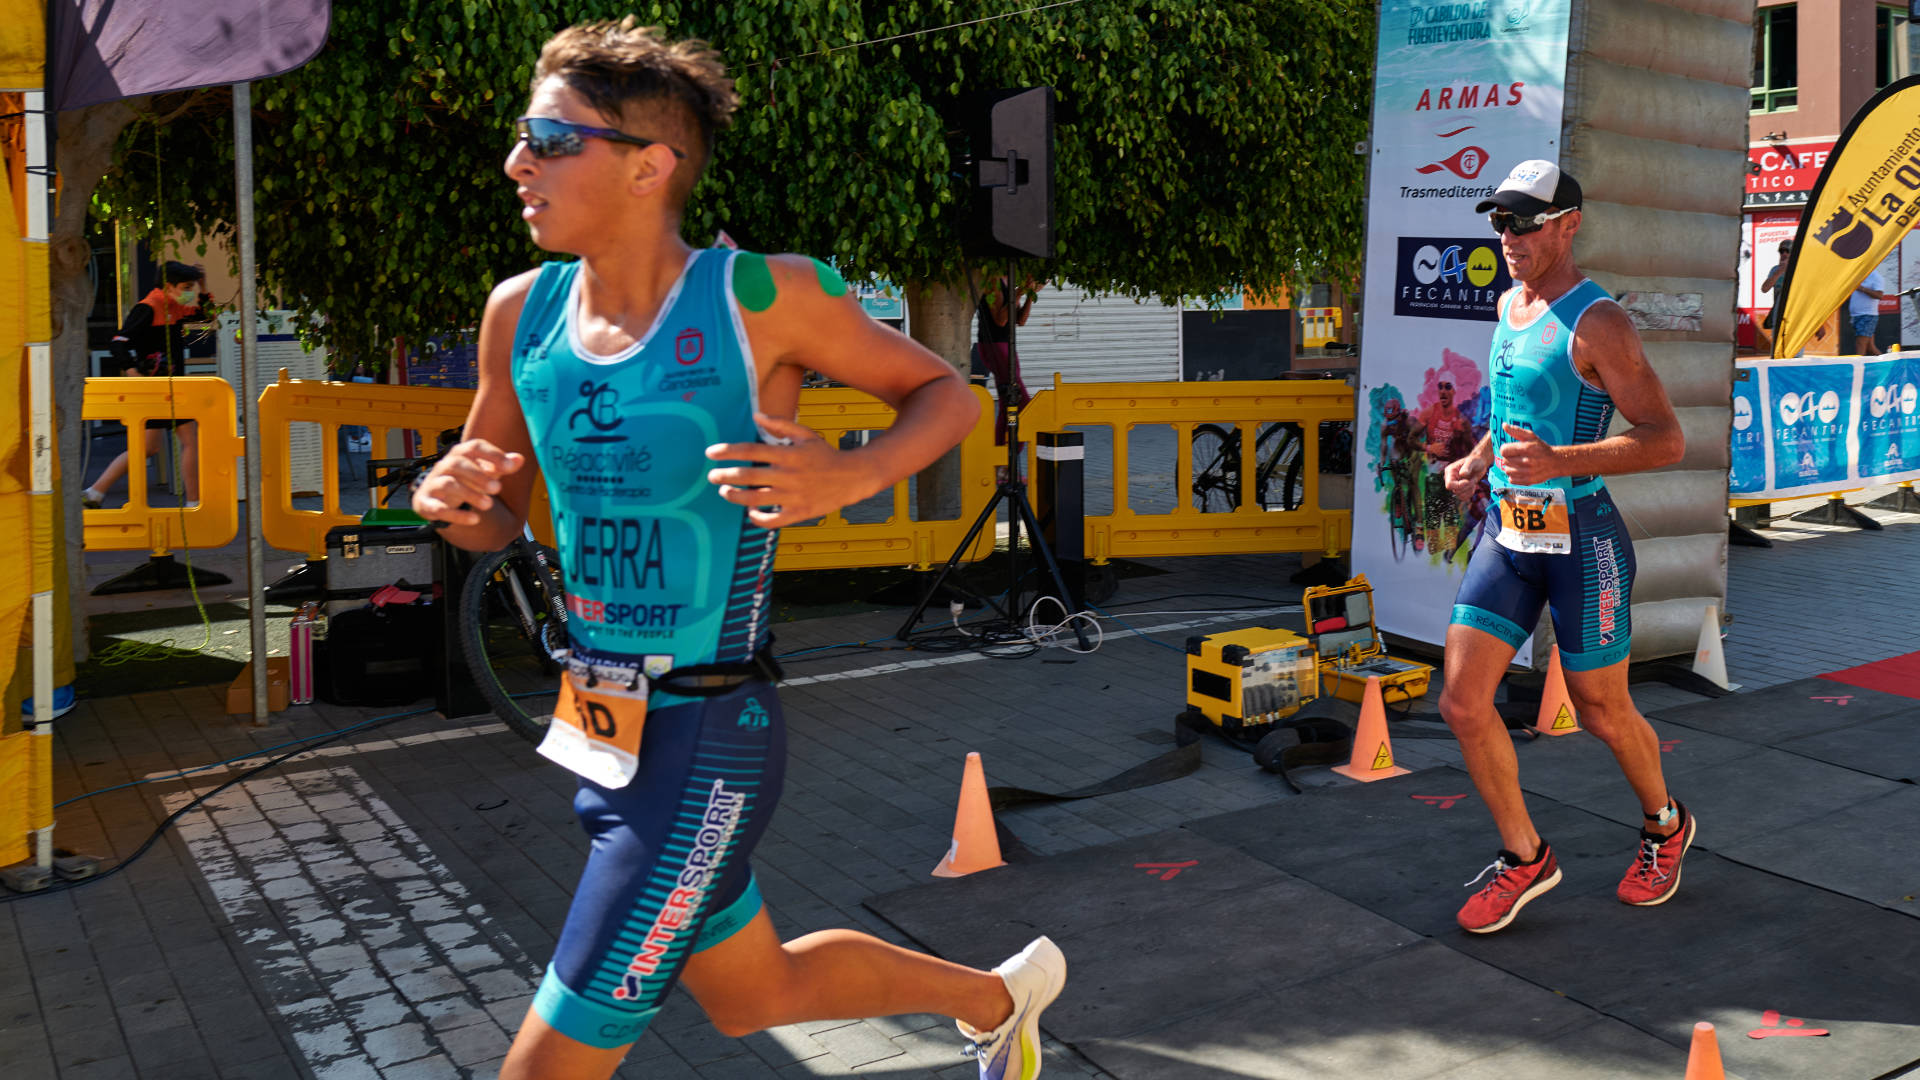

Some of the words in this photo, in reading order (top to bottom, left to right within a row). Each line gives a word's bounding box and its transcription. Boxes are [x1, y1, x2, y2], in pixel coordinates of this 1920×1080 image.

[1425, 4, 1470, 23] CABILDO
[1472, 2, 1487, 19] DE
[1408, 22, 1491, 45] FUERTEVENTURA
[1416, 82, 1525, 111] ARMAS
[1861, 193, 1905, 227] La
[1513, 507, 1546, 531] 6B
[1594, 537, 1616, 632] INTERSPORT
[628, 779, 736, 976] INTERSPORT
